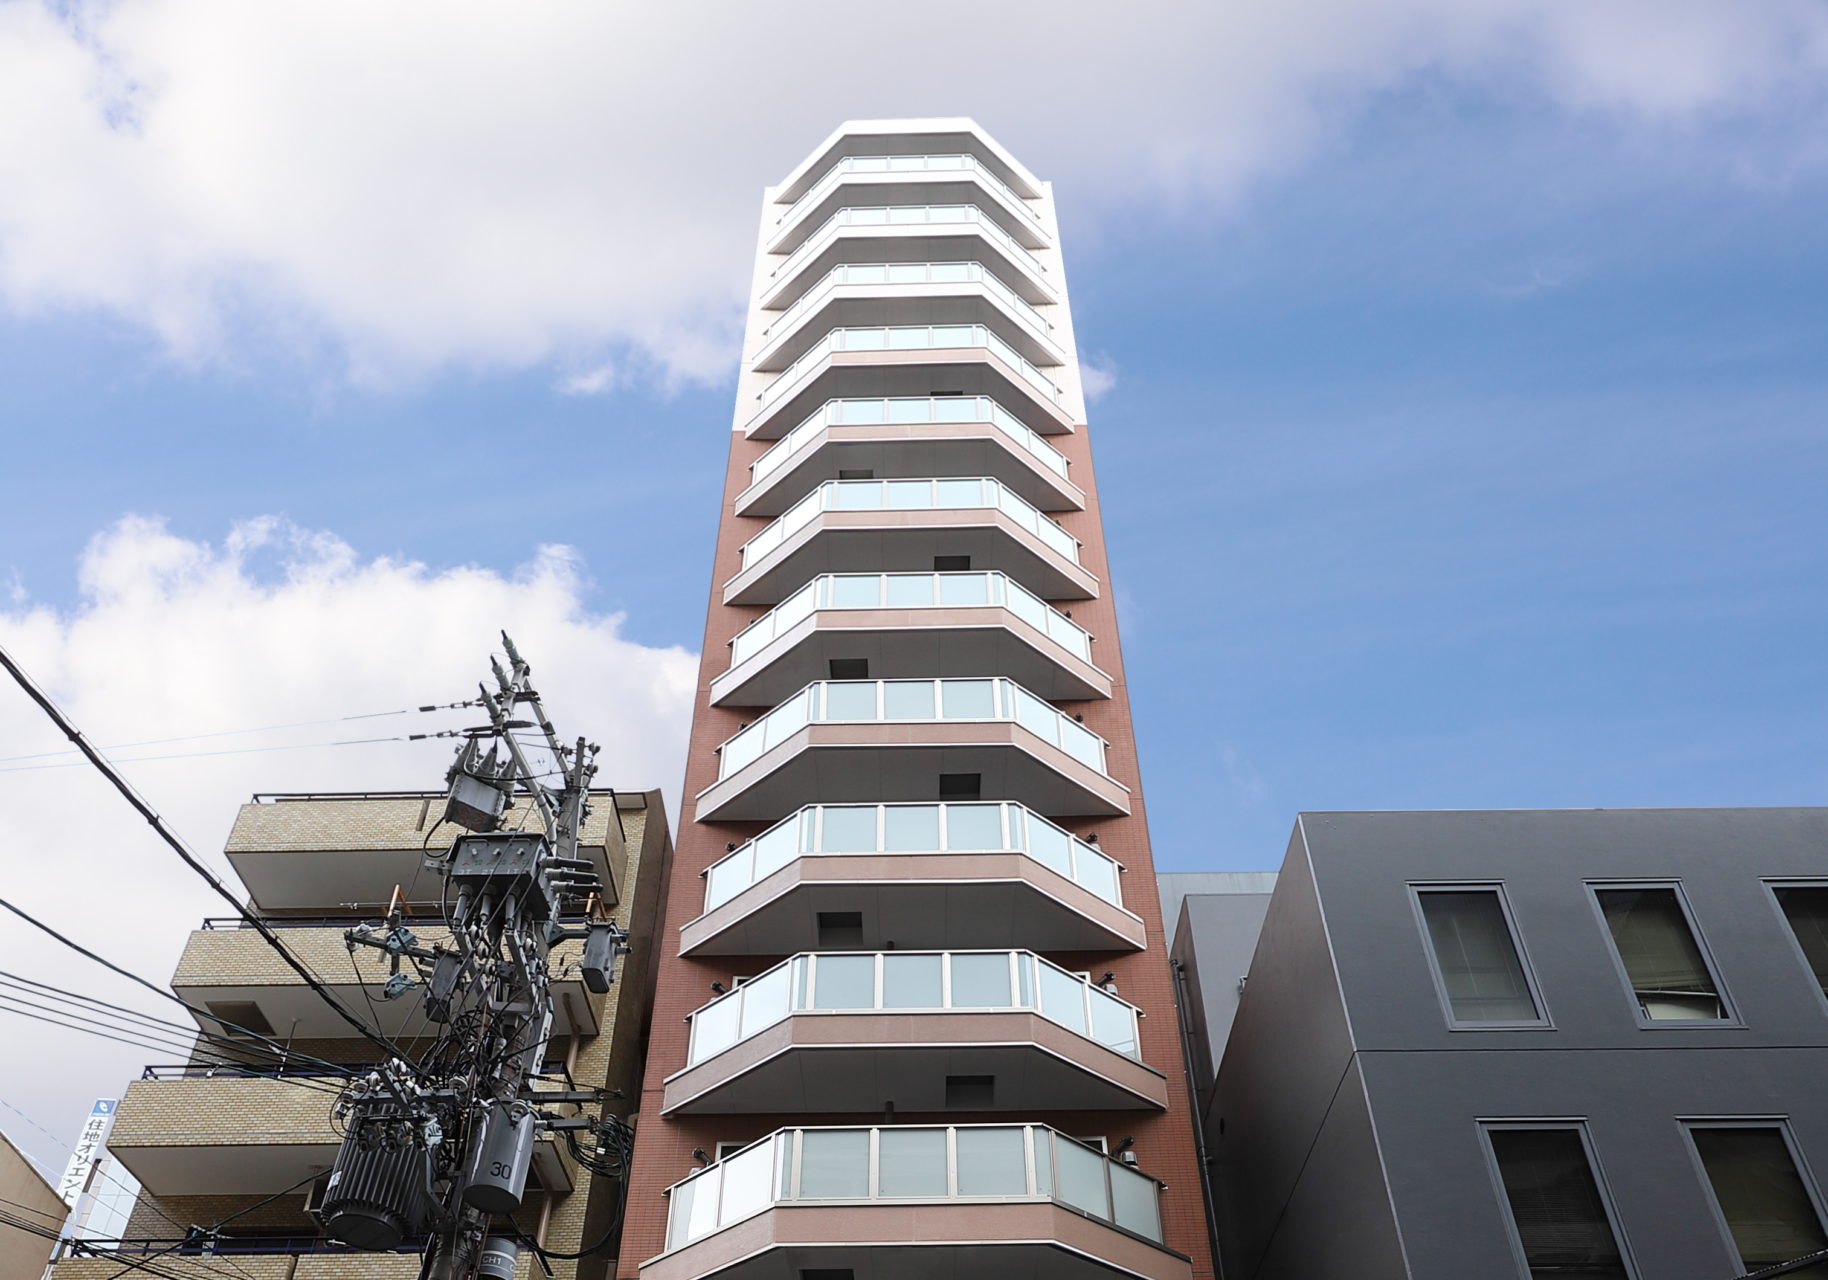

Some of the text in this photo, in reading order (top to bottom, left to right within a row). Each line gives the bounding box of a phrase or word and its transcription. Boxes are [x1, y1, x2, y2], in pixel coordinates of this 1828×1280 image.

[63, 1119, 105, 1202] 住地オリエント
[490, 1161, 513, 1180] 30
